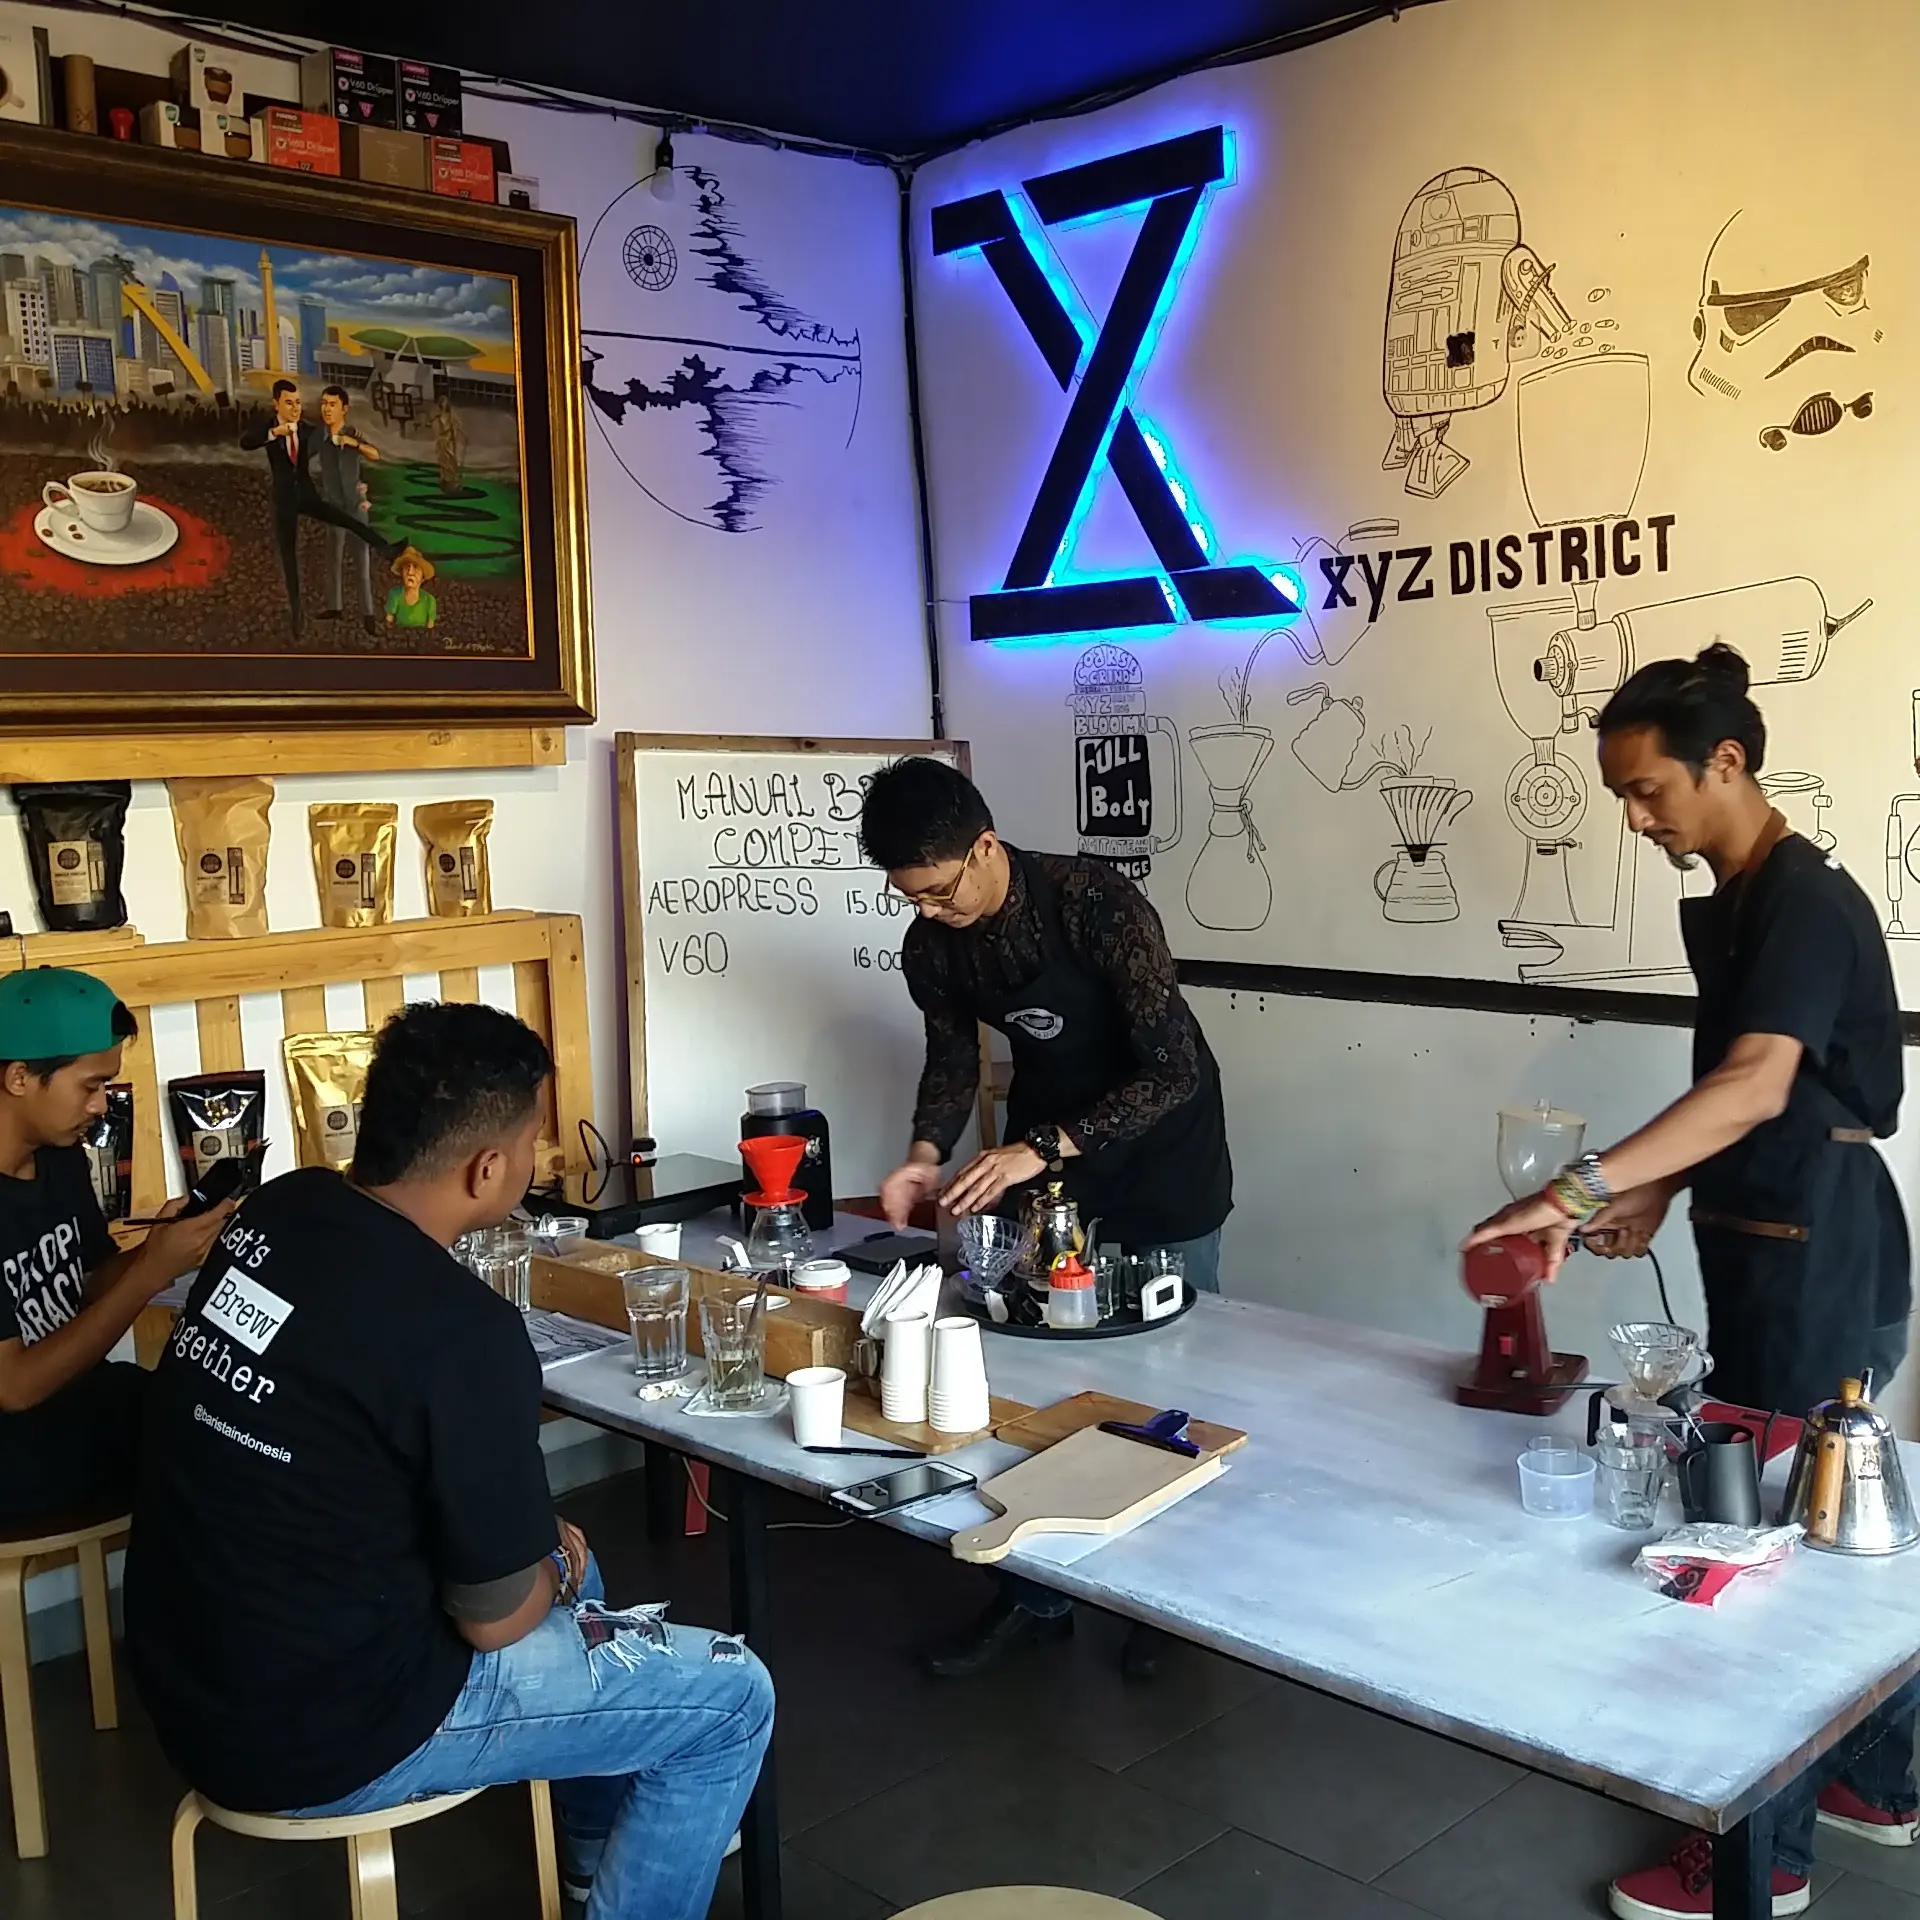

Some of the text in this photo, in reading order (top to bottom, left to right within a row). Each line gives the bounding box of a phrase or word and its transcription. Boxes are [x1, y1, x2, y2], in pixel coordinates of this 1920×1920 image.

[1449, 514, 1676, 596] DISTRICT
[1074, 715, 1146, 736] BLOOM!
[676, 772, 815, 820] MANUAL
[1079, 736, 1142, 832] FULL
[647, 872, 819, 916] AEROPRESS
[658, 931, 729, 975] V60
[219, 1212, 270, 1269] Let's
[209, 1277, 280, 1340] Brew
[172, 1316, 276, 1404] ogether
[194, 1403, 293, 1464] @baristaindonesia
